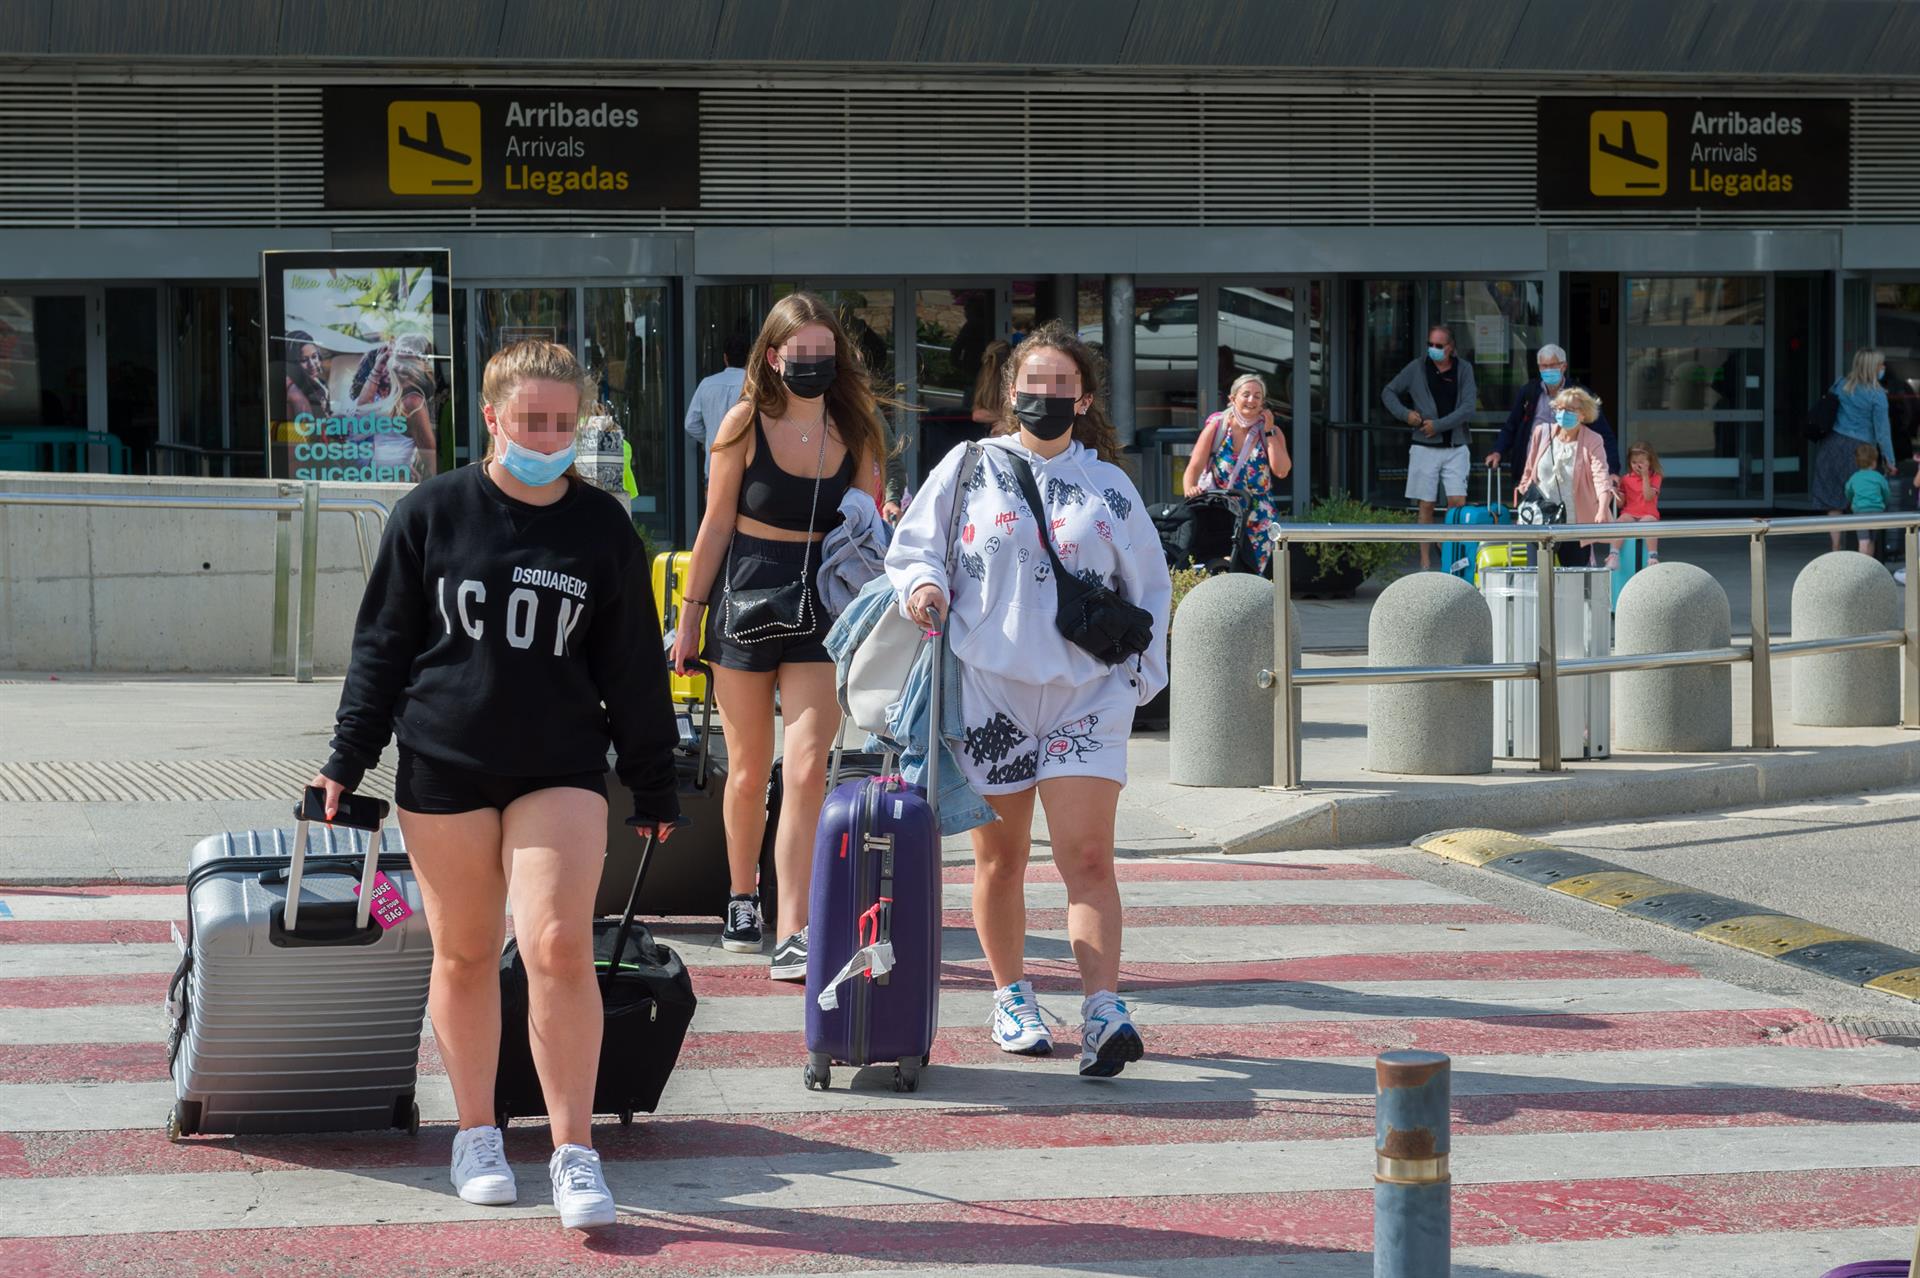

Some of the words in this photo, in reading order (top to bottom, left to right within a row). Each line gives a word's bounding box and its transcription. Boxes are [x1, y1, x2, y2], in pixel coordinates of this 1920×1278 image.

[505, 102, 639, 128] Arribades
[1691, 111, 1803, 135] Arribades
[505, 135, 585, 157] Arrivals
[1691, 142, 1757, 162] Arrivals
[505, 165, 629, 195] Llegadas
[1690, 168, 1793, 197] Llegadas
[294, 411, 408, 436] Grandes
[294, 441, 374, 462] cosas
[295, 461, 411, 483] suceden
[995, 511, 1019, 527] HELL
[512, 566, 588, 599] DSQUARED2
[371, 881, 392, 900] CUSE
[384, 906, 405, 923] BAG!
[386, 899, 400, 909] YOUR
